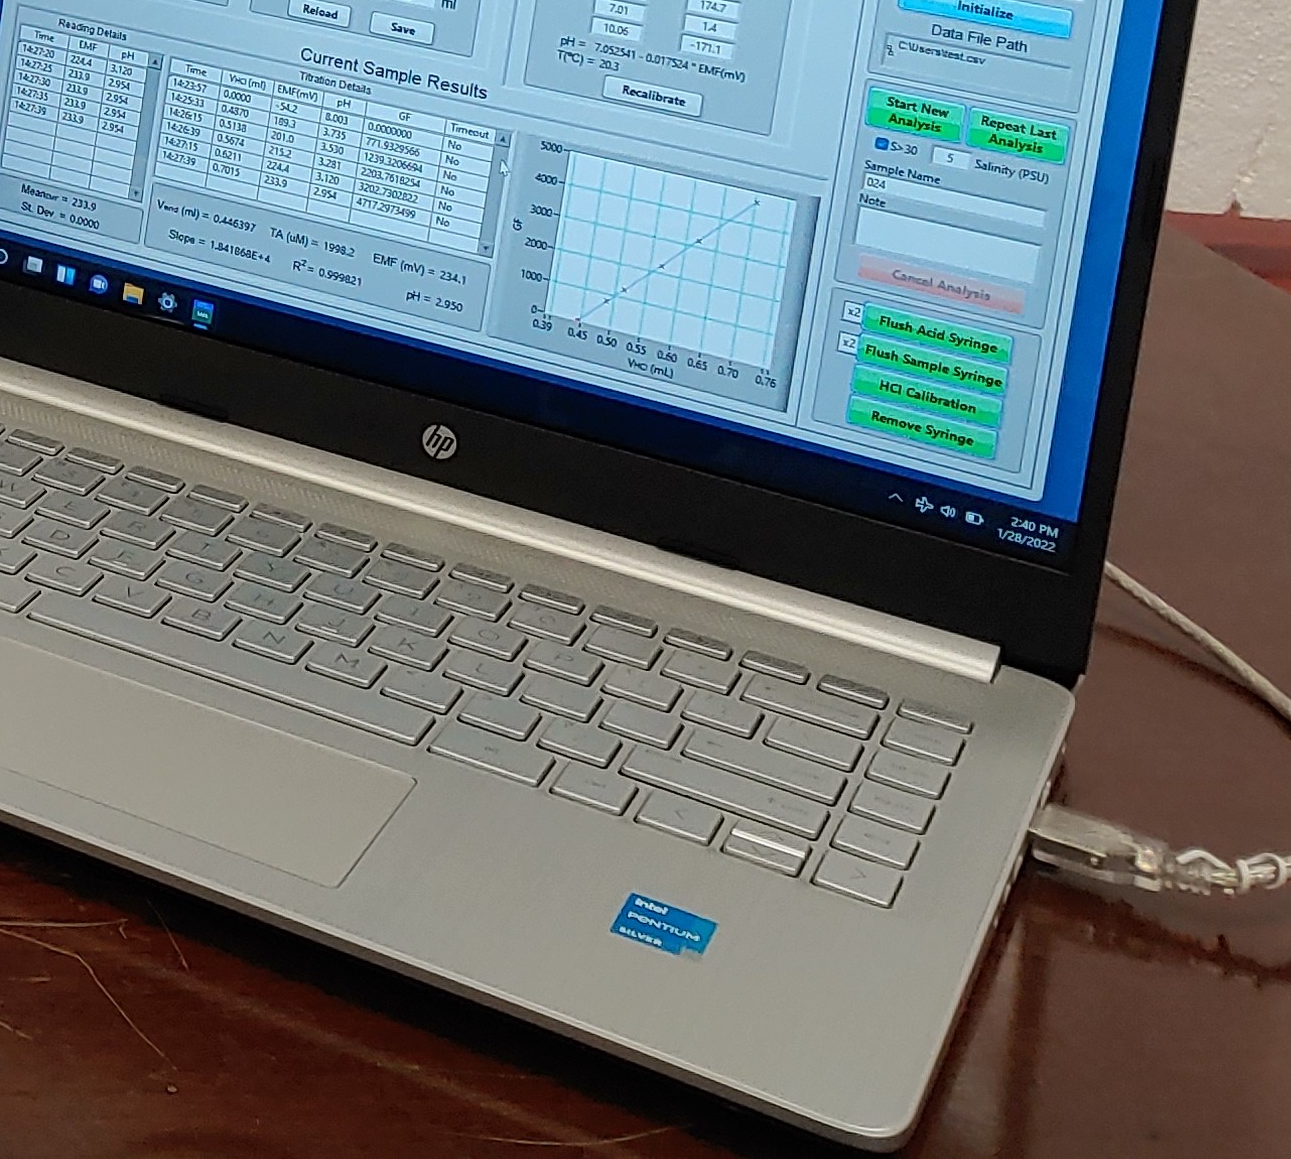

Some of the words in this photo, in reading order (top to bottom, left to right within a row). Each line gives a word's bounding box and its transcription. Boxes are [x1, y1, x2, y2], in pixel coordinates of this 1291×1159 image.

[302, 4, 338, 21] Reload
[958, 0, 1014, 20] Initialize
[58, 18, 95, 36] Reading
[97, 26, 127, 41] Details
[390, 20, 416, 38] Save
[932, 23, 963, 42] Data
[968, 31, 992, 46] File
[996, 36, 1028, 54] Path
[34, 30, 55, 42] Time
[121, 50, 135, 61] pH
[301, 48, 358, 72] Current
[364, 60, 422, 85] Sample
[428, 74, 488, 100] Results
[600, 58, 620, 72] 20.3
[300, 70, 336, 88] Titration
[338, 80, 372, 95] Details
[185, 64, 208, 77] Time
[278, 84, 318, 102] EMF(mV)
[336, 98, 352, 109] pH
[398, 111, 412, 122] GF
[450, 122, 490, 140] Timeout
[622, 84, 686, 108] Recalibrate
[887, 96, 919, 113] Start
[921, 104, 950, 118] New
[888, 113, 942, 134] Analysis
[980, 116, 1026, 136] Repeat
[1030, 126, 1056, 142] Last
[448, 139, 462, 150] No
[988, 134, 1043, 156] Analysis
[445, 154, 460, 166] No
[442, 170, 458, 182] No
[864, 160, 906, 179] Sample
[908, 169, 940, 186] Name
[974, 158, 1016, 179] Salinity
[1018, 168, 1050, 186] (PSU)
[440, 185, 455, 196] No
[858, 193, 886, 208] Note
[37, 205, 55, 218] Dev
[438, 200, 452, 212] No
[436, 216, 450, 228] No
[270, 227, 284, 240] TA
[373, 252, 397, 268] EMF
[168, 228, 196, 246] Slope
[406, 290, 421, 304] pH
[892, 269, 933, 288] Cancel
[938, 280, 991, 302] Analysis
[879, 315, 914, 334] Flush
[916, 325, 946, 342] Acid
[949, 332, 998, 355] Syringe
[865, 344, 899, 363] Flush
[903, 354, 950, 375] Sample
[953, 364, 1003, 388] Syringe
[879, 379, 902, 396] HCl
[906, 387, 977, 414] Calibration
[871, 410, 922, 432] Remove
[926, 424, 974, 448] Syringe
[426, 425, 454, 459] hp
[1011, 516, 1036, 532] 2:40
[1039, 524, 1059, 538] PM
[997, 528, 1057, 553] 1/28/2022
[635, 898, 668, 915] intel
[618, 926, 662, 946] SILVER
[627, 910, 701, 942] PENTIUM
